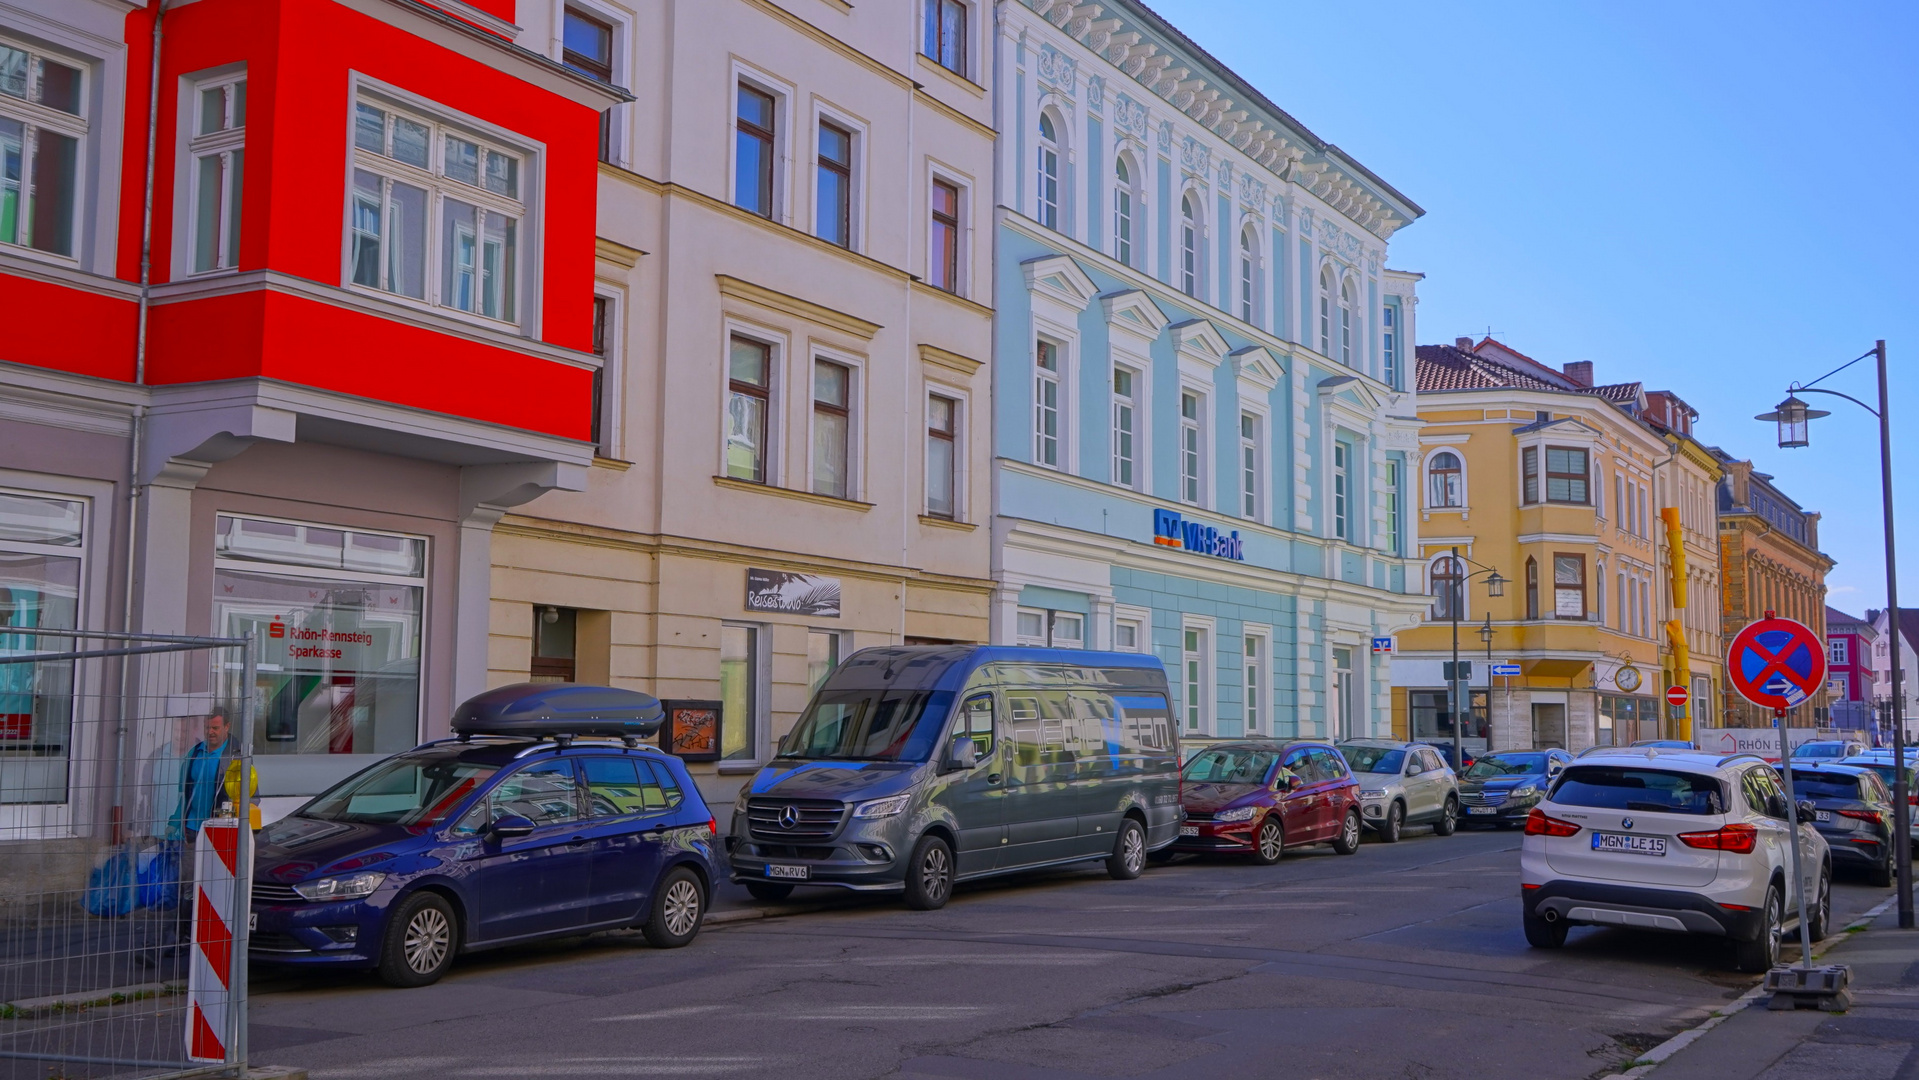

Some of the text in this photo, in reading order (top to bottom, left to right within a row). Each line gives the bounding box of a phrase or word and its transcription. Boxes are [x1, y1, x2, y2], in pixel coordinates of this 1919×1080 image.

[1181, 520, 1245, 560] VR-Bank
[289, 627, 372, 646] Rhön-Rennsteig
[288, 644, 342, 659] Sparkasse
[1738, 738, 1798, 750] RHÖN BU
[1600, 834, 1664, 851] MGN LE 15
[770, 866, 785, 876] MGN
